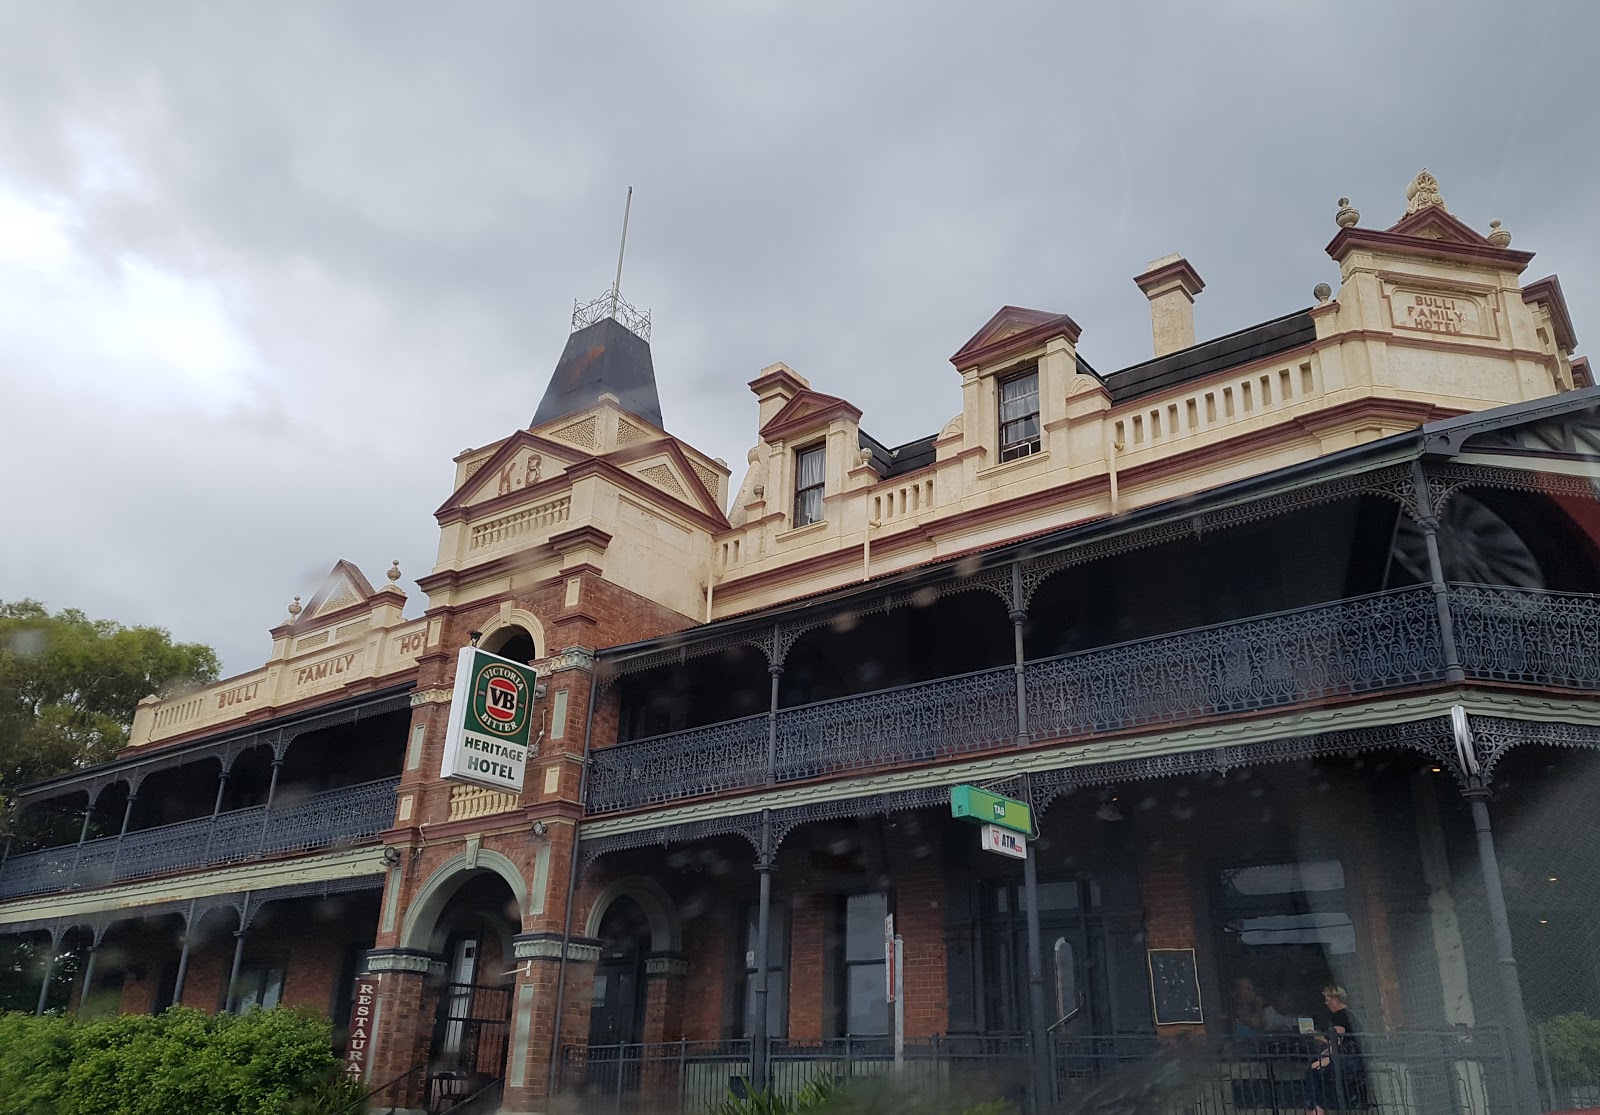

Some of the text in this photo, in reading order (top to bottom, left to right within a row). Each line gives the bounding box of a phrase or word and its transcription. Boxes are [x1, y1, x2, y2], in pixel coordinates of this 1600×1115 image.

[1415, 296, 1454, 310] BULLI
[1407, 306, 1462, 322] FAMILY
[1414, 318, 1461, 334] HOTEL
[217, 683, 260, 709] BULLI
[297, 653, 356, 686] FAMILY
[483, 667, 524, 692] VICTORIA
[489, 686, 516, 711] VB
[480, 712, 518, 732] BITTER
[464, 736, 524, 763] HERITAGE
[467, 755, 515, 781] HOTEL
[994, 804, 1005, 816] TAB
[1002, 834, 1016, 849] ATM
